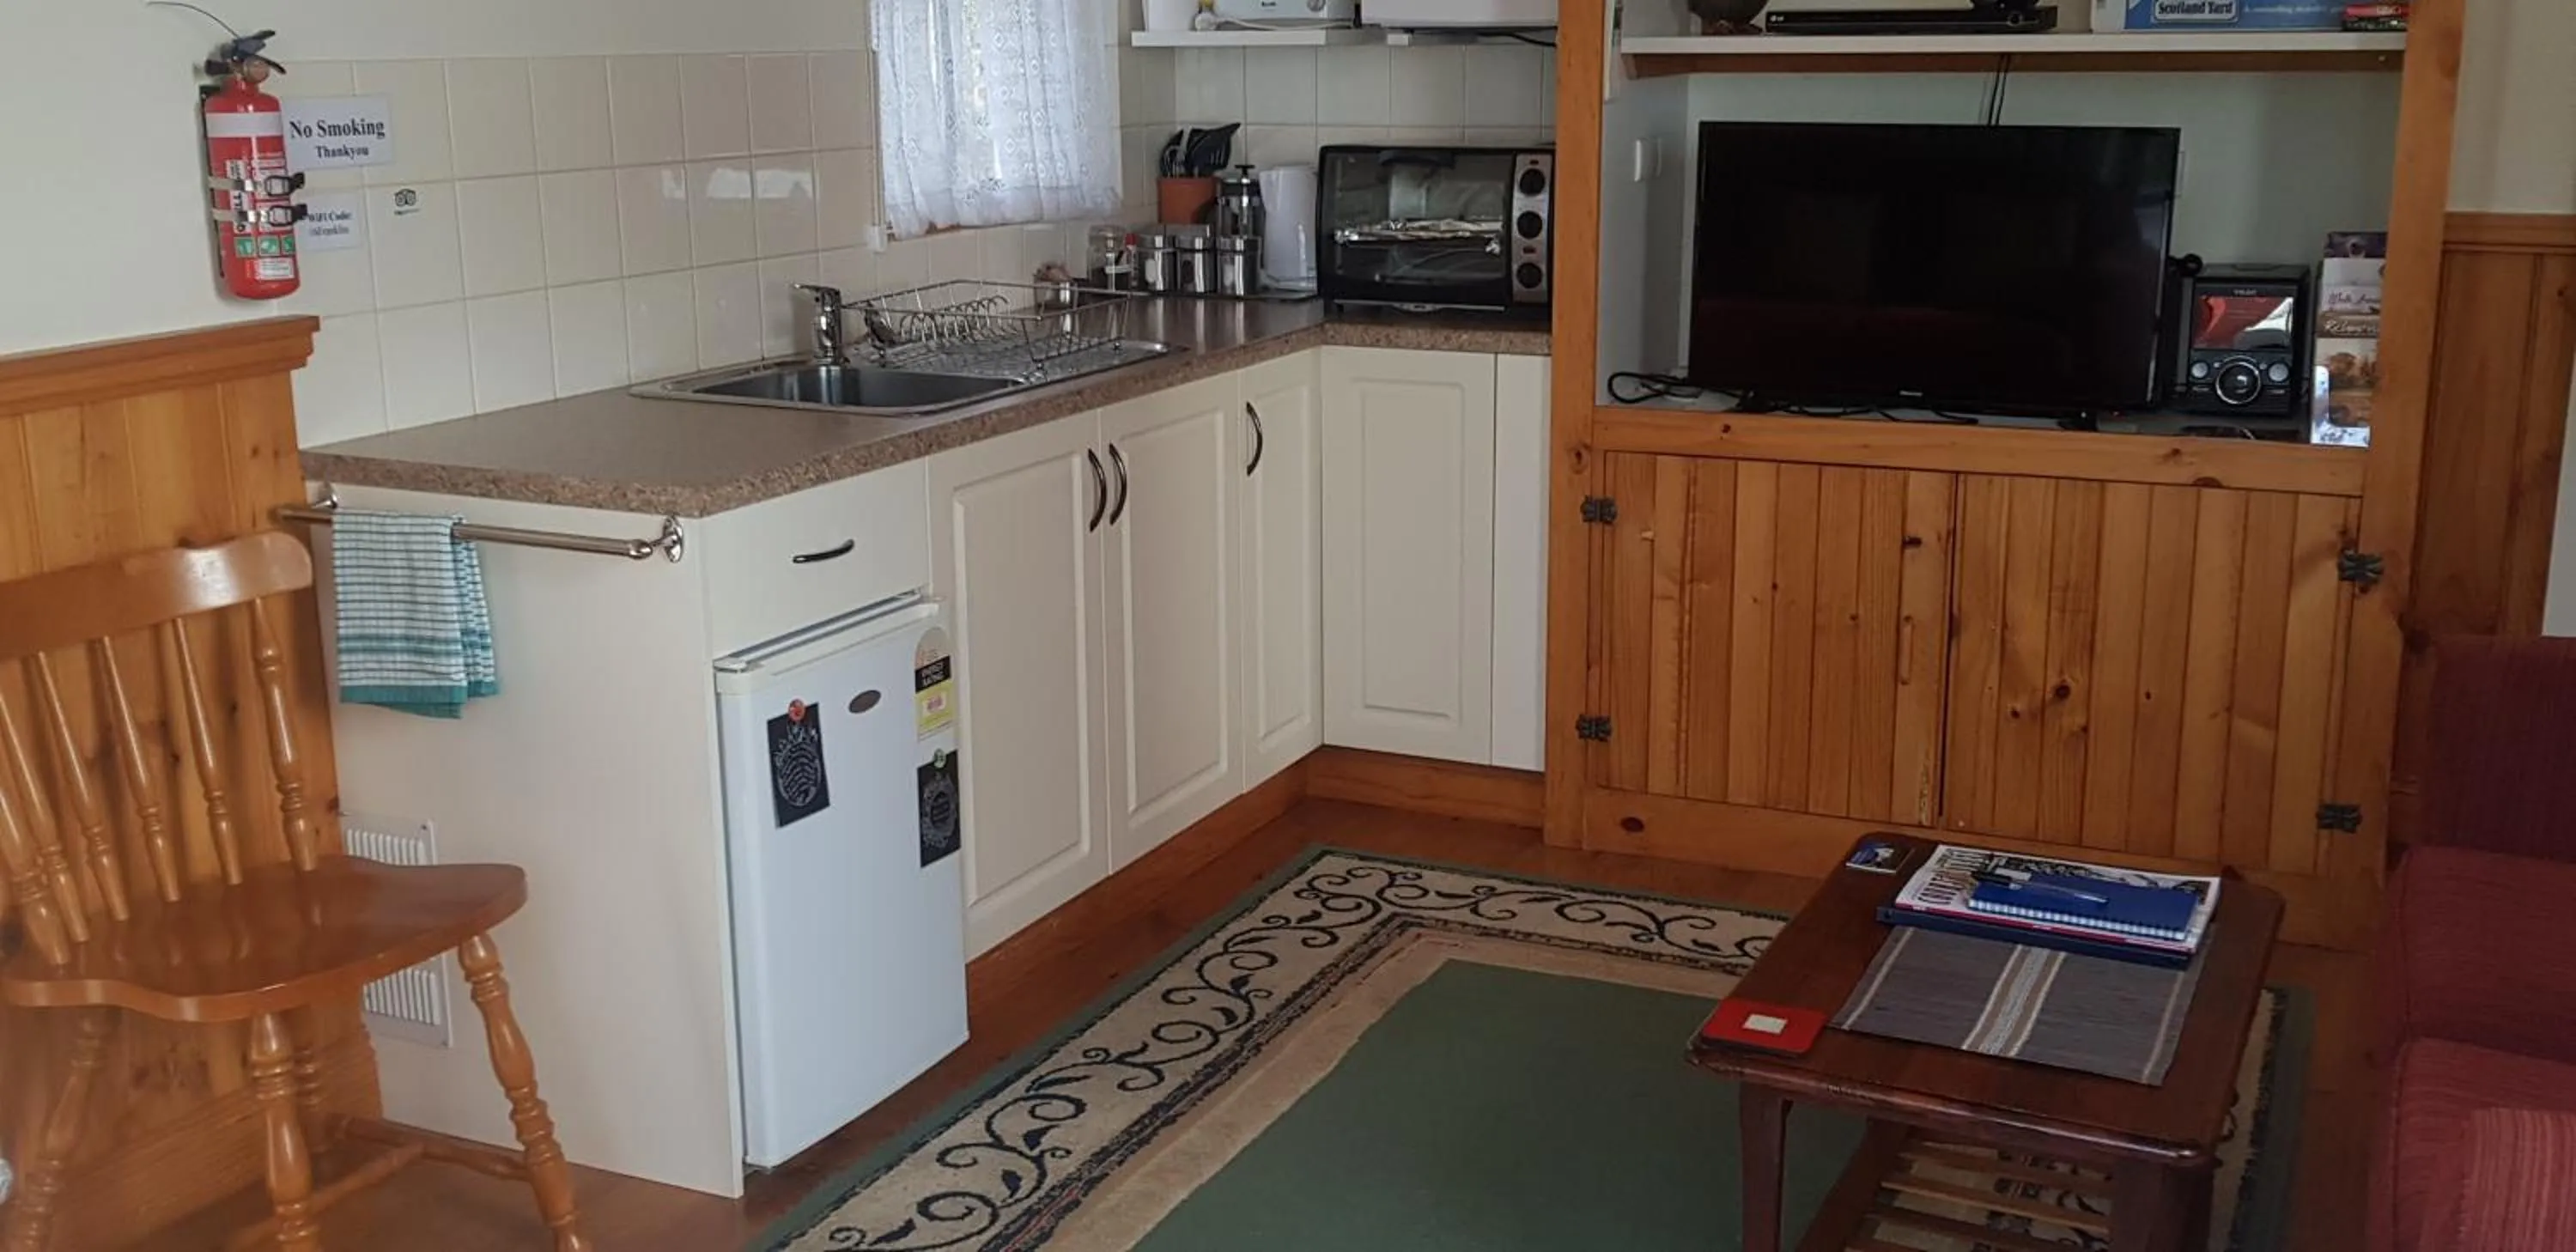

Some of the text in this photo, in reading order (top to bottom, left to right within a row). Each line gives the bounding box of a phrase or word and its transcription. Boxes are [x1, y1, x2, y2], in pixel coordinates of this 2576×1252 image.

[2157, 1, 2206, 15] Scotland
[2208, 1, 2233, 15] Yard
[289, 118, 386, 139] No Smoking
[315, 143, 369, 160] Thankyou
